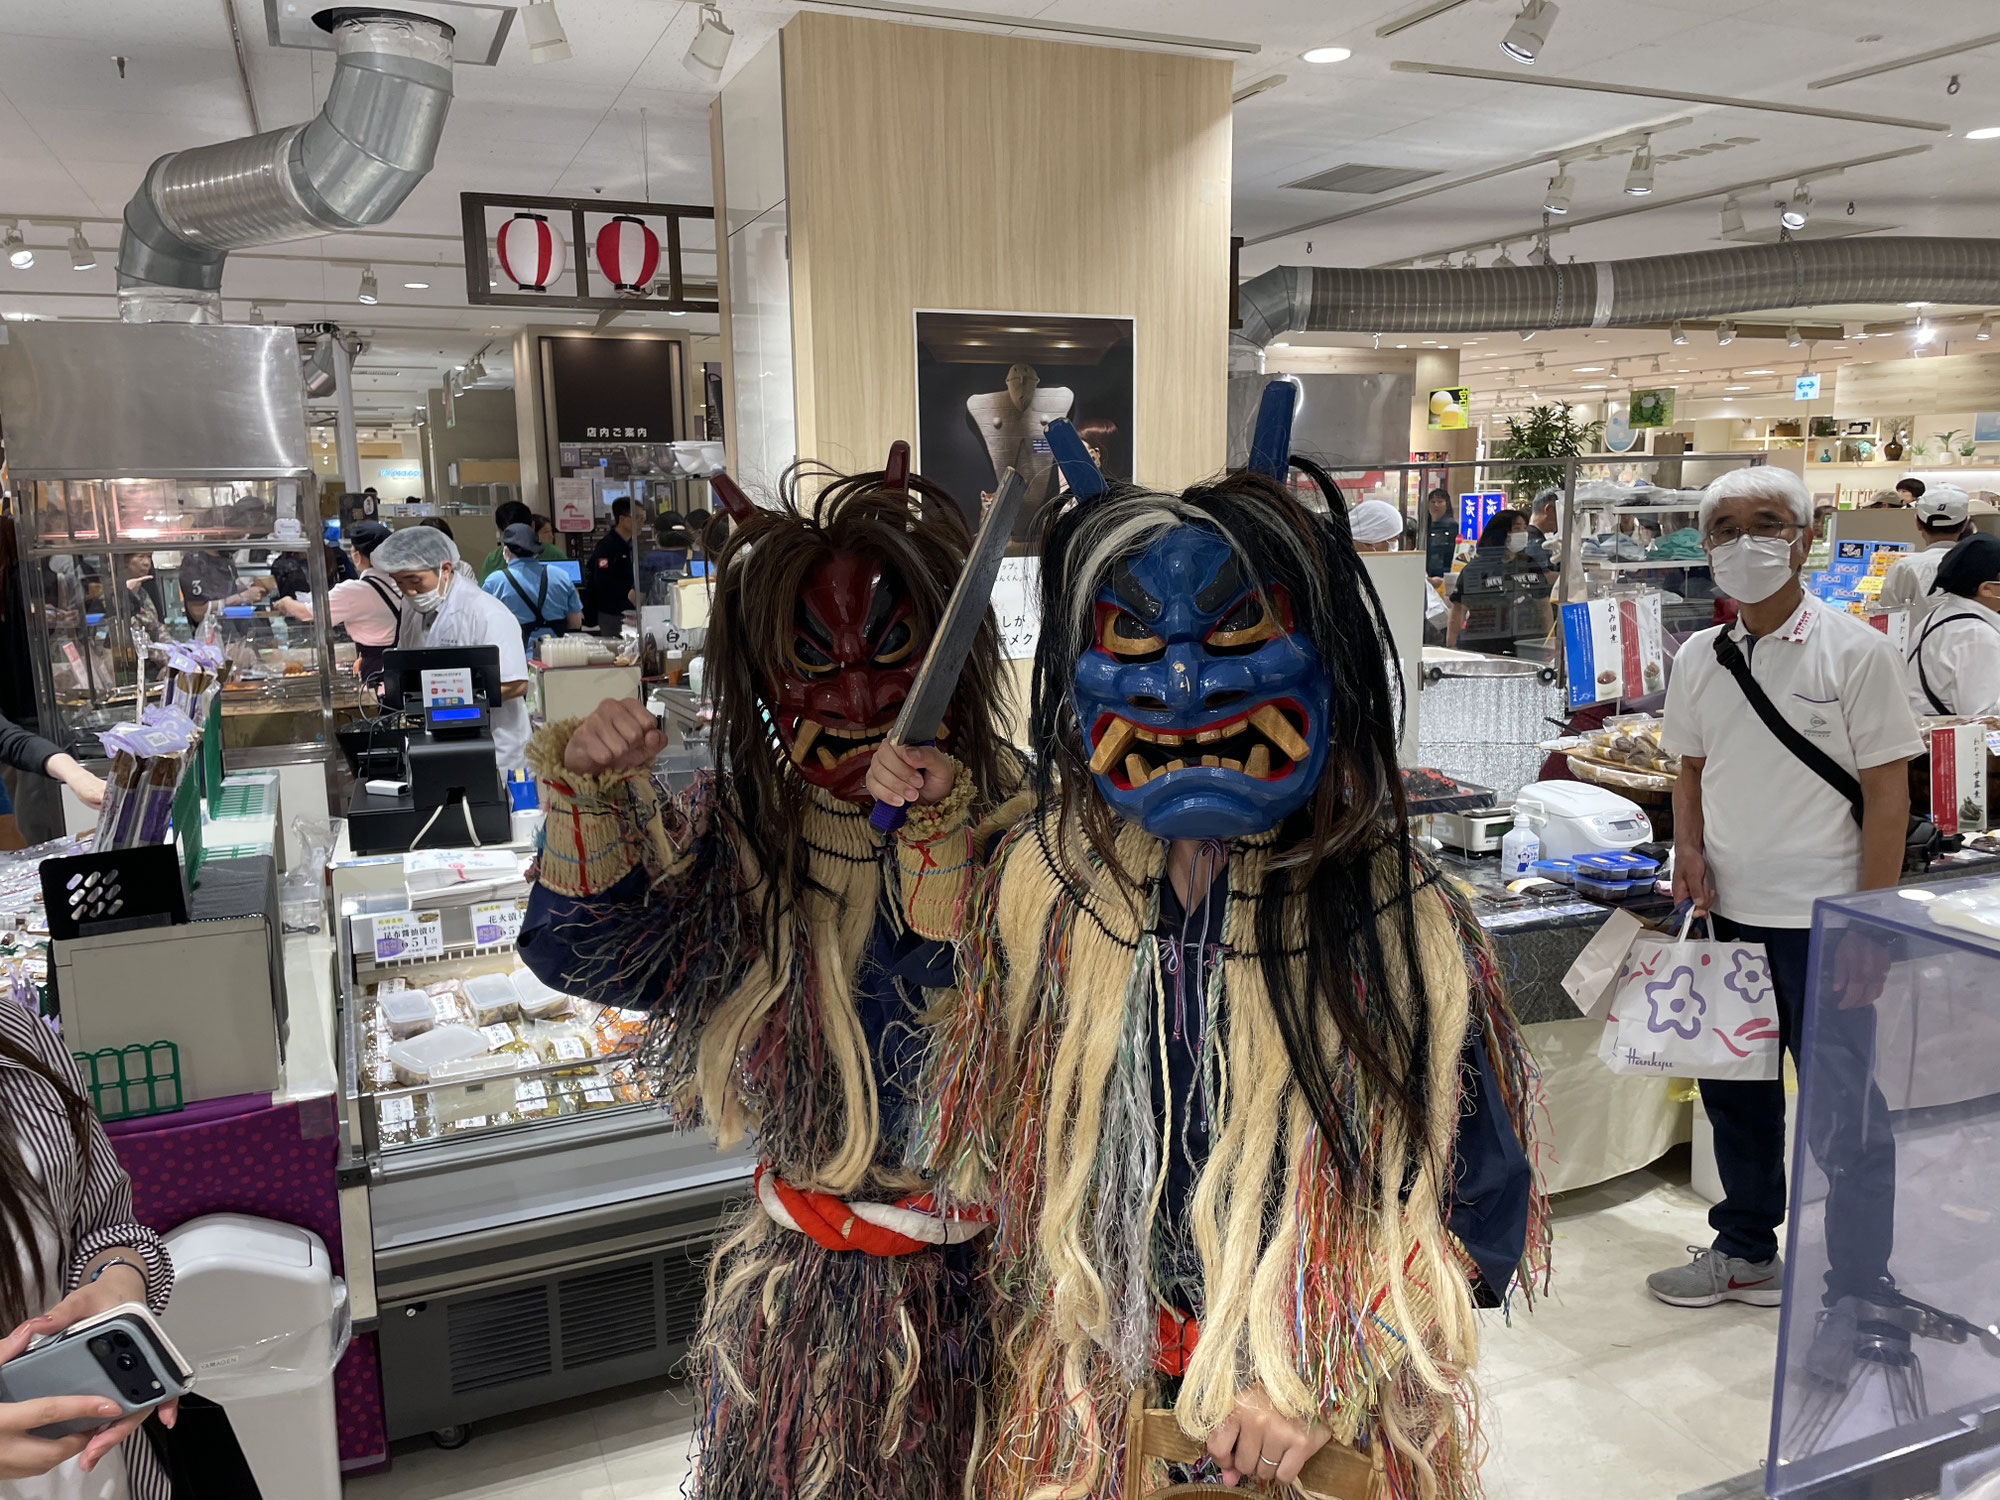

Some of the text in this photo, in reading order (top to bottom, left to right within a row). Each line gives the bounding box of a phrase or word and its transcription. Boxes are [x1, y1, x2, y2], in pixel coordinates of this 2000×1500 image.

[586, 427, 648, 438] 店内ご案内
[191, 579, 203, 596] 3
[1625, 1048, 1675, 1071] Hankyu
